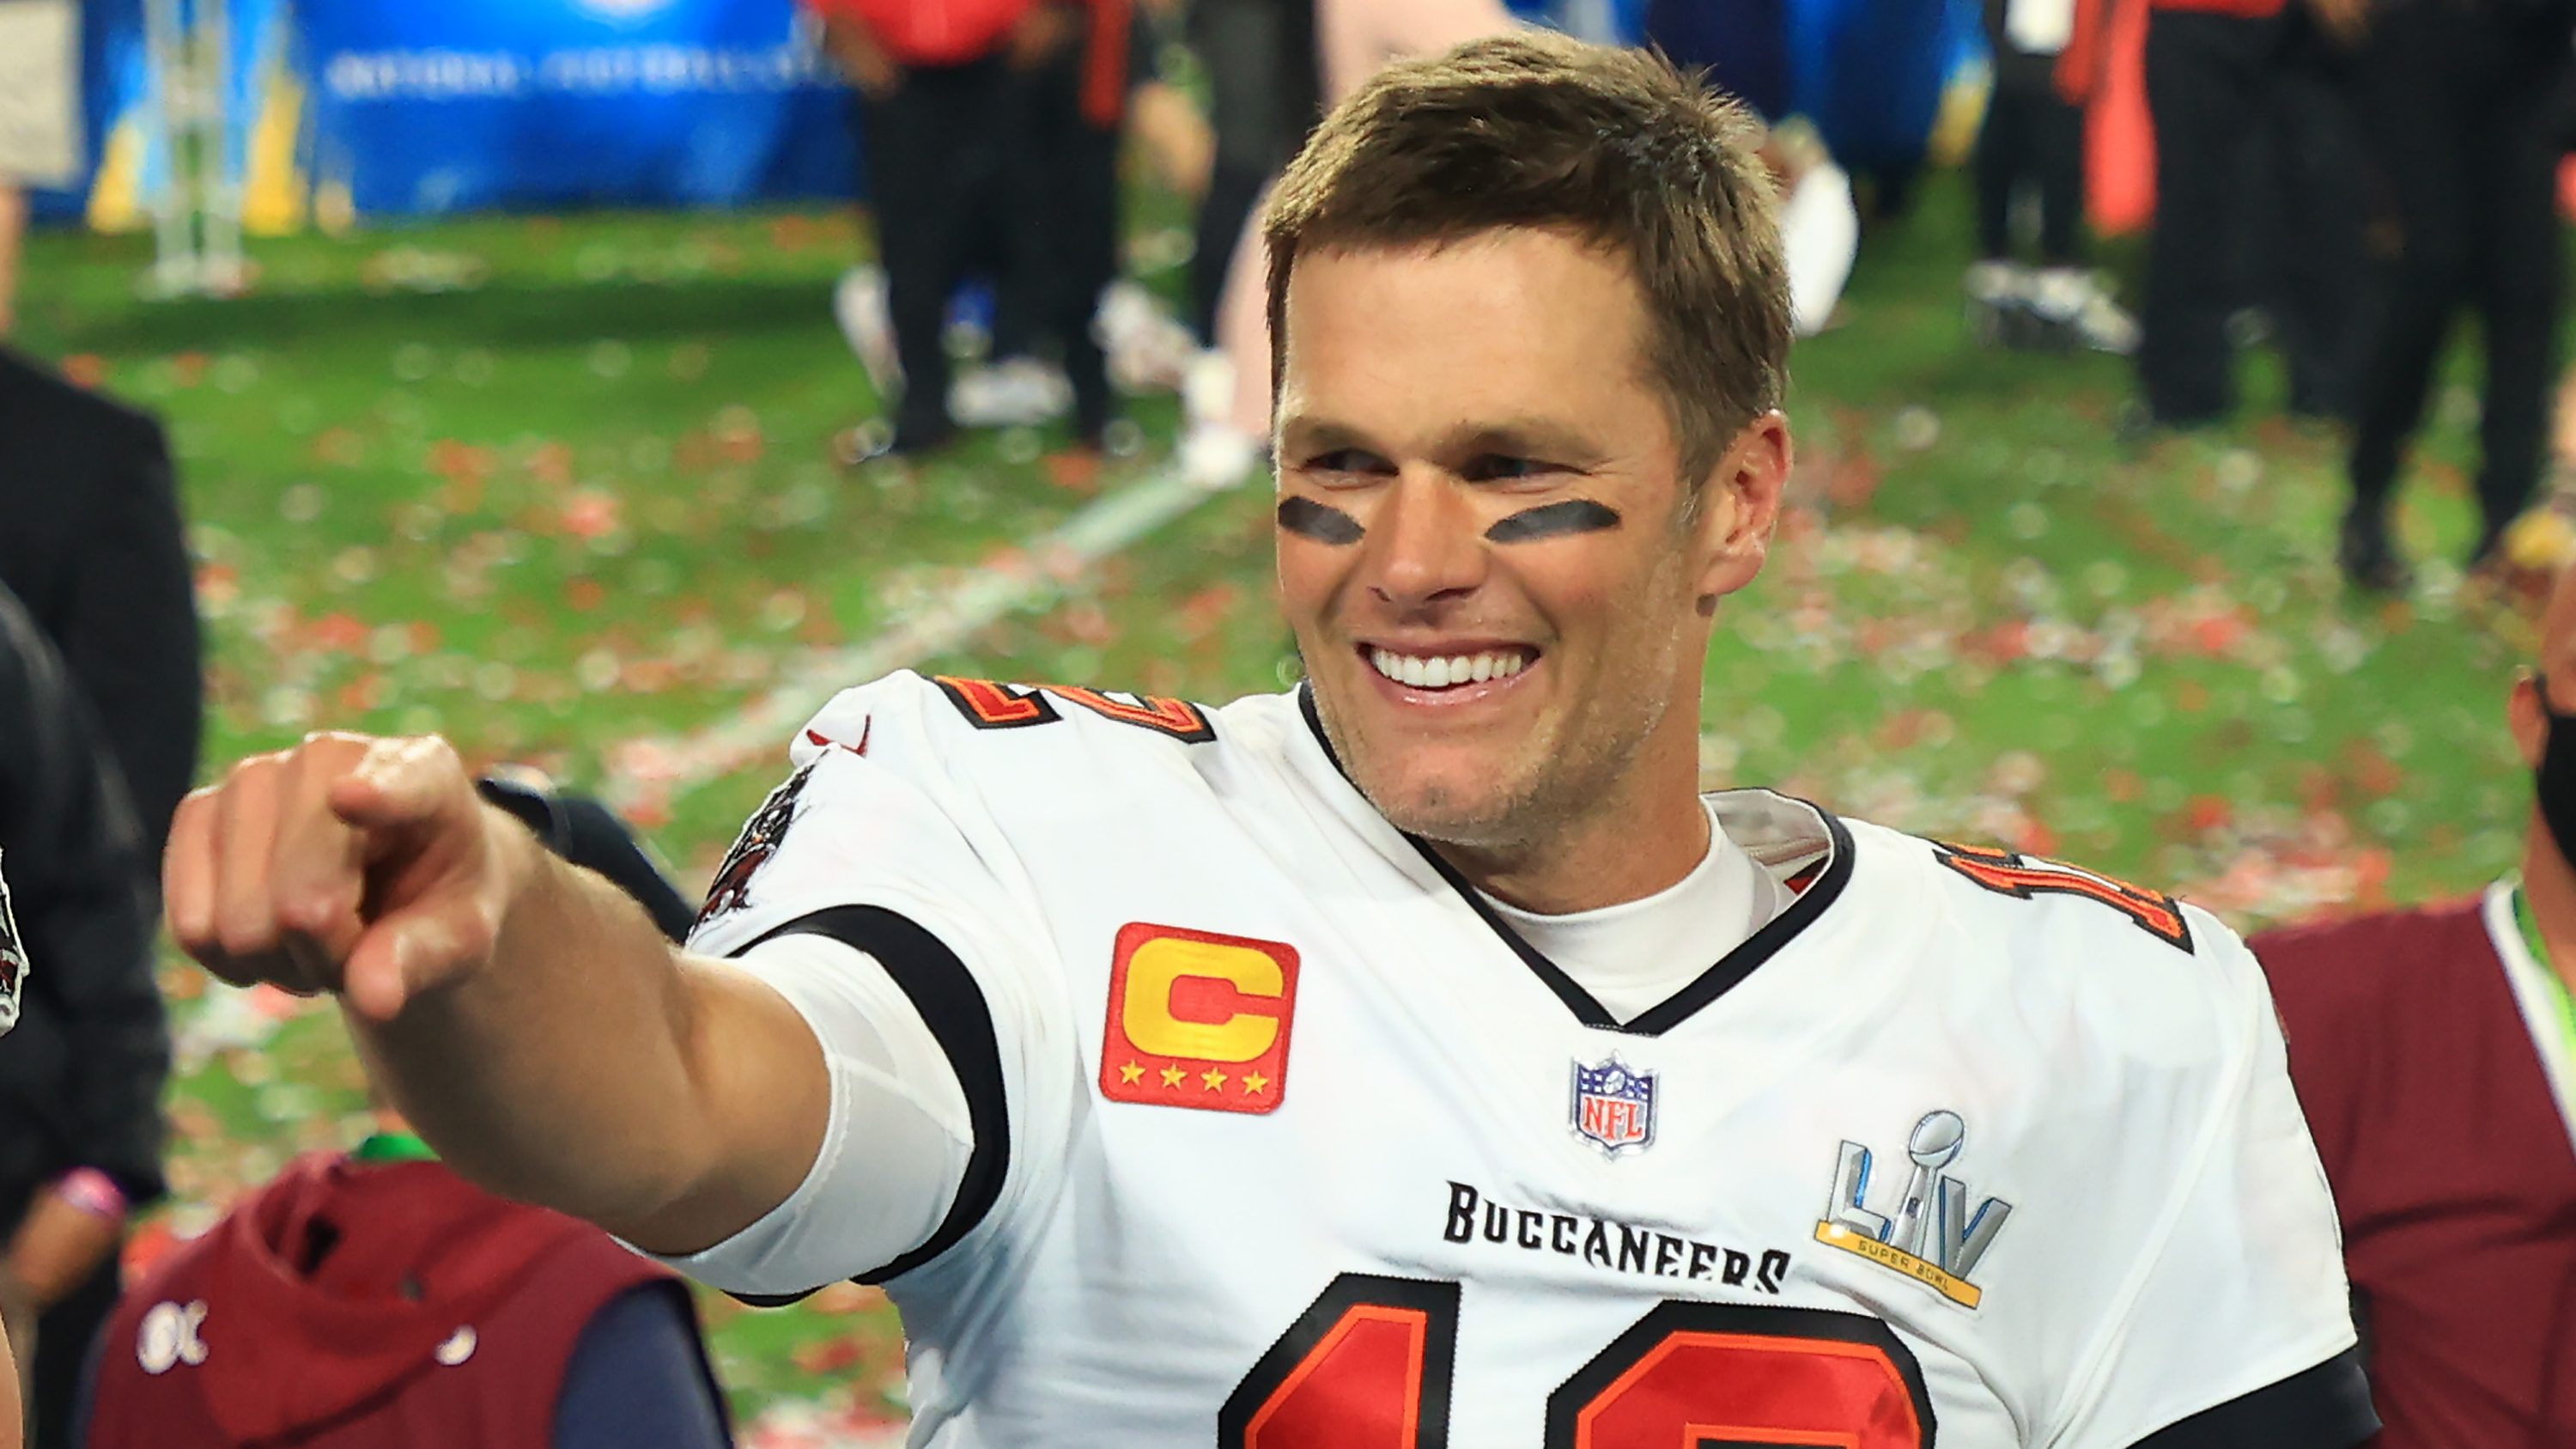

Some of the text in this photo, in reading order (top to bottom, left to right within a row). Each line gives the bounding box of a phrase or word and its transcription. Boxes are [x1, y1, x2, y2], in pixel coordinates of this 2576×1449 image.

[1122, 937, 1284, 1062] C
[1583, 1096, 1643, 1141] NFL
[1443, 1179, 1791, 1294] BUCCANEERS
[1858, 1239, 1949, 1291] SUPER BOWL
